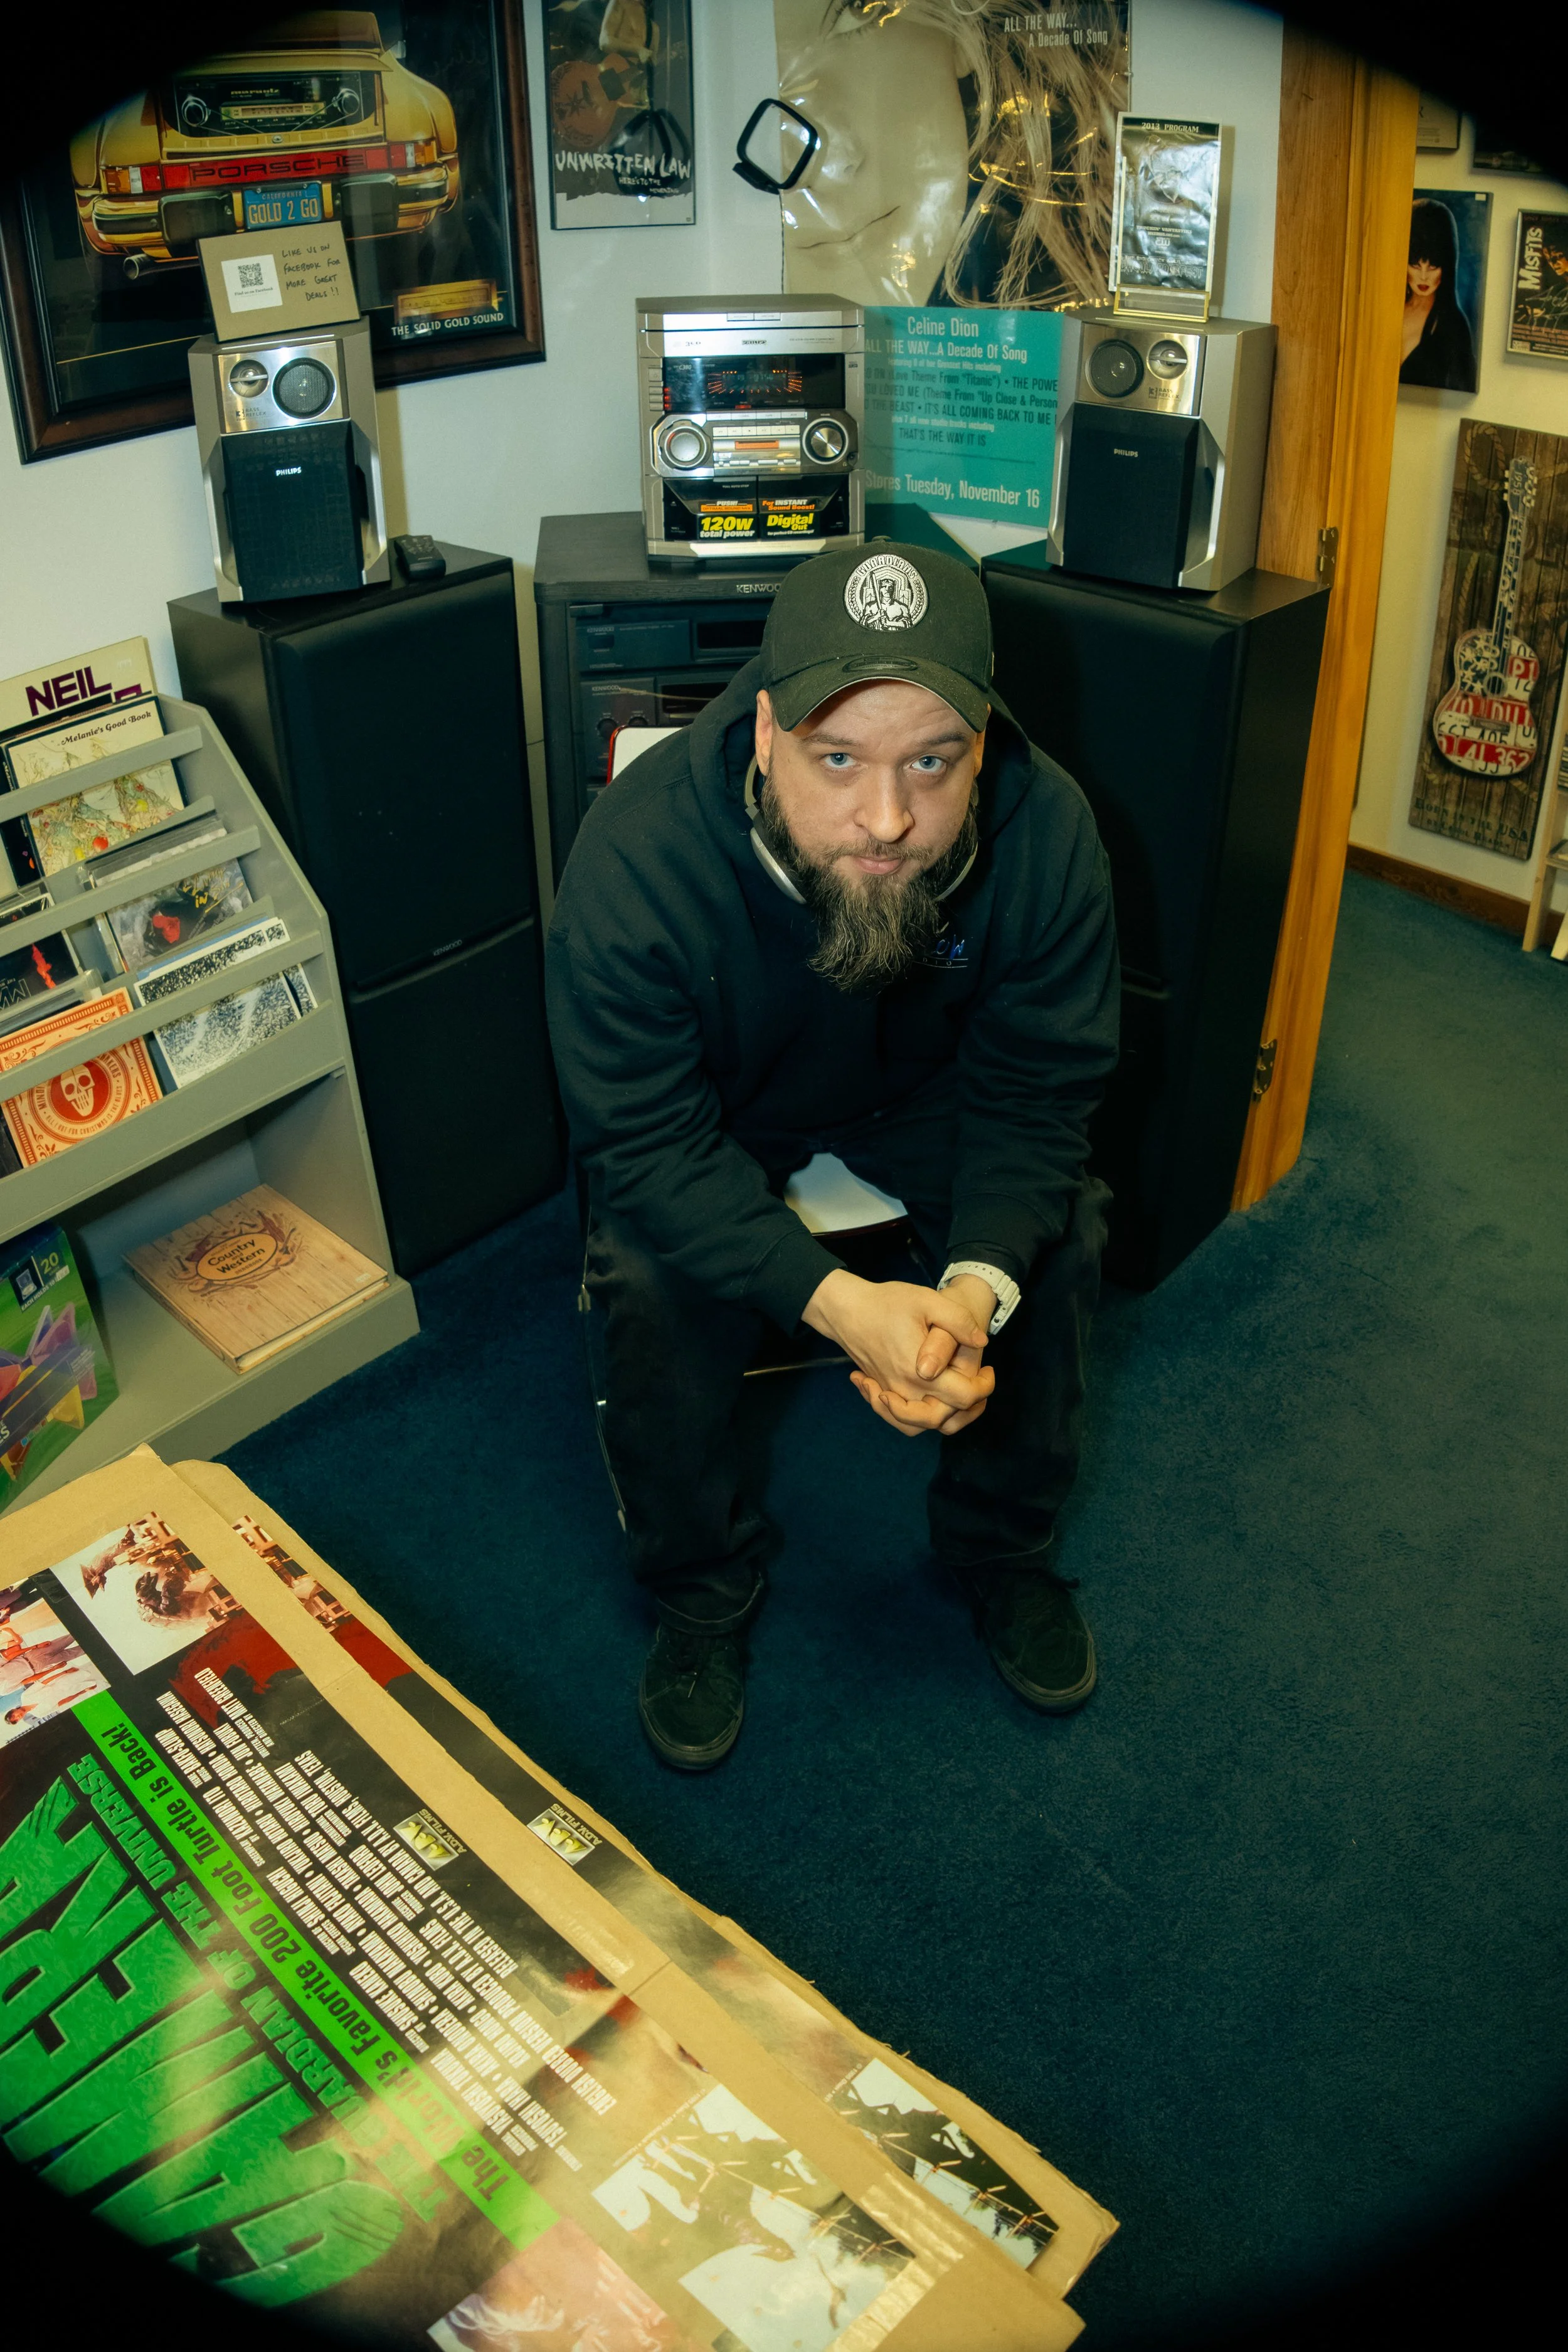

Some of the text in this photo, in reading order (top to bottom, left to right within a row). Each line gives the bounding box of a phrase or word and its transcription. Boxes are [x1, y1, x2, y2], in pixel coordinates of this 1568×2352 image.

[1004, 18, 1020, 33] ALL
[1024, 16, 1042, 30] THE
[1029, 29, 1108, 47] A Decade Of Song
[1142, 122, 1199, 133] 2013 PROGRAM
[191, 154, 364, 181] PORSCHE
[555, 150, 690, 179] UNWRITTEN LAW
[248, 198, 319, 225] GOLD 2 GO
[282, 250, 301, 258] LIKE
[283, 262, 320, 274] FACEBOOK
[286, 275, 337, 290] MORE GREAT
[306, 292, 327, 301] DEALS
[391, 312, 504, 336] THE SOLID GOLD SOUND
[908, 316, 978, 337] Celine Dion
[865, 340, 881, 352] ALL
[886, 339, 903, 353] THE
[948, 342, 983, 358] Decade
[987, 344, 999, 358] Of
[1002, 344, 1027, 364] Song
[940, 372, 959, 384] From
[1012, 377, 1028, 389] THE
[1032, 378, 1058, 391] POWE
[908, 386, 919, 397] ME
[955, 389, 974, 401] From
[996, 393, 1017, 405] Close
[1020, 395, 1025, 405] &
[1030, 396, 1057, 408] Person
[943, 404, 956, 416] ALL
[960, 406, 993, 420] COMING
[997, 408, 1019, 421] BACK
[1024, 410, 1034, 423] TO
[1037, 412, 1051, 425] ME
[929, 430, 944, 443] THE
[946, 431, 965, 445] WAY
[967, 433, 975, 445] IT
[978, 435, 986, 446] IS
[1113, 448, 1138, 457] PHILIPS
[275, 466, 302, 477] PHILIPS
[1512, 470, 1523, 496] 1958
[866, 470, 1039, 508] Stores Tuesday, November 16
[767, 513, 814, 528] Digital
[723, 531, 755, 539] power
[856, 555, 918, 580] GUARDIANS
[736, 583, 781, 593] KENWOO
[25, 666, 112, 717] NEIL
[61, 711, 151, 745] Melanie's Good Book
[433, 938, 463, 956] KENWOOD
[80, 1118, 108, 1135] CHRISTMAS
[40, 1252, 60, 1274] 20
[208, 1239, 255, 1266] Country
[216, 1248, 265, 1273] Western
[21, 1286, 50, 1311] EACH HOLDS
[194, 1665, 247, 1722] MATT GREENFIELD
[300, 1790, 328, 1818] TORU
[66, 1750, 179, 1890] UNIVERSE
[418, 1807, 467, 1855] A.D.V. FILMS
[549, 1802, 602, 1846] A.D.V. FILMS
[156, 1688, 437, 2011] SHINOBU NAKAYAMA AYAKO HOTARU HIROTARO HONDA HASEGAWA
[230, 1740, 475, 2011] AKIRA HAKAMADA TAKASHI MATSUO WATANABE JUN
[294, 1747, 519, 1979] RELEASED IN THE U.S.A. AND CANADA BY A.D.V. FILMS, HOUSTON, TEXAS
[347, 1843, 405, 1900] JOHN LEDFORD
[265, 1863, 326, 1929] SHINJI HIGUCHI
[160, 1878, 225, 1951] THE
[100, 1719, 512, 2201] The World's Favorite 200 Foot Turtle is Back!
[206, 1938, 259, 1994] OF
[348, 1959, 419, 2032] SHUSUKE KANEKO
[418, 1917, 618, 2116] ENGLISH DUBBED VERSION PRODUCED BY A.D.V. FILMS
[0, 1776, 405, 2308] GAMERA
[240, 1981, 390, 2152] GUARDIAN
